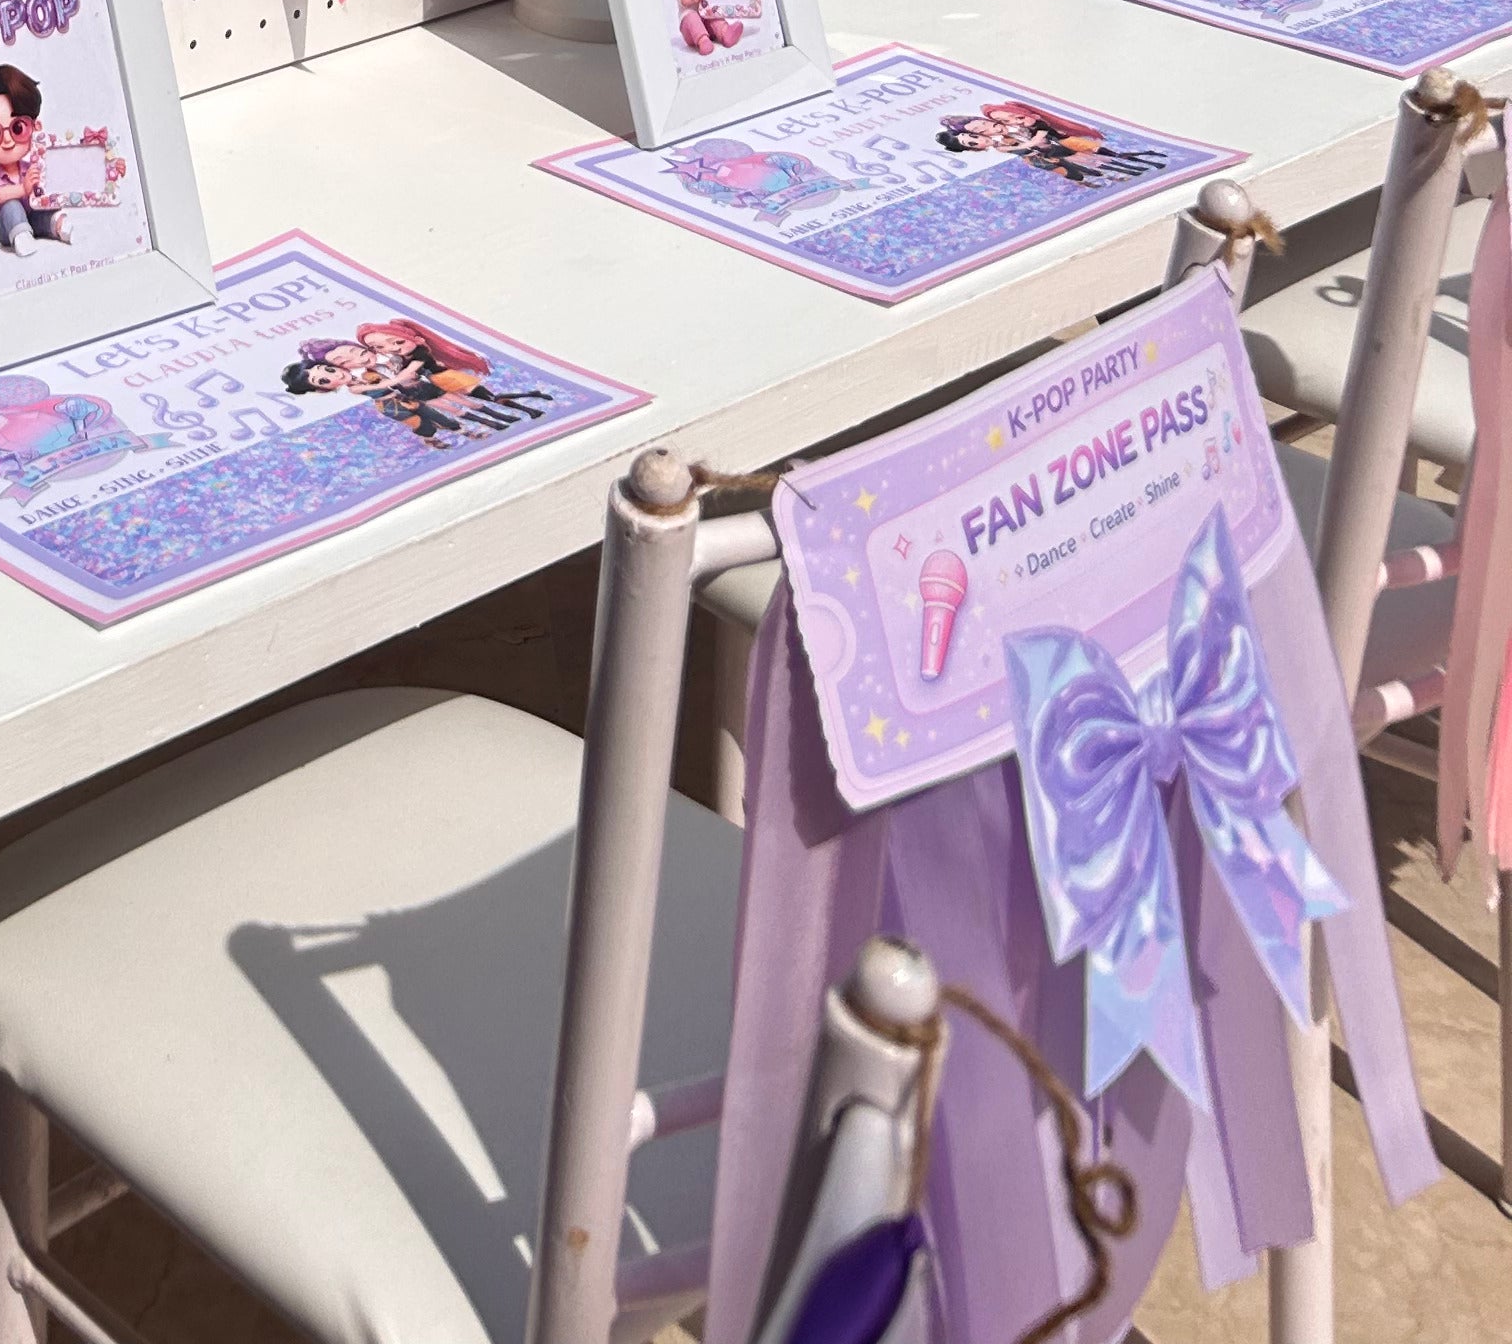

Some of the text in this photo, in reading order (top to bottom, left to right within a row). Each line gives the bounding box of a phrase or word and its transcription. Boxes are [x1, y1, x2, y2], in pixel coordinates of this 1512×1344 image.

[750, 69, 945, 142] Let's K-POP!
[58, 274, 330, 379] Let's K-POP!
[122, 295, 358, 389] CLAUDIA turns 5
[1007, 342, 1138, 438] K-POP PARTY
[961, 385, 1209, 555] FAN ZONE PASS
[1026, 472, 1180, 575] Dance Create Shine
